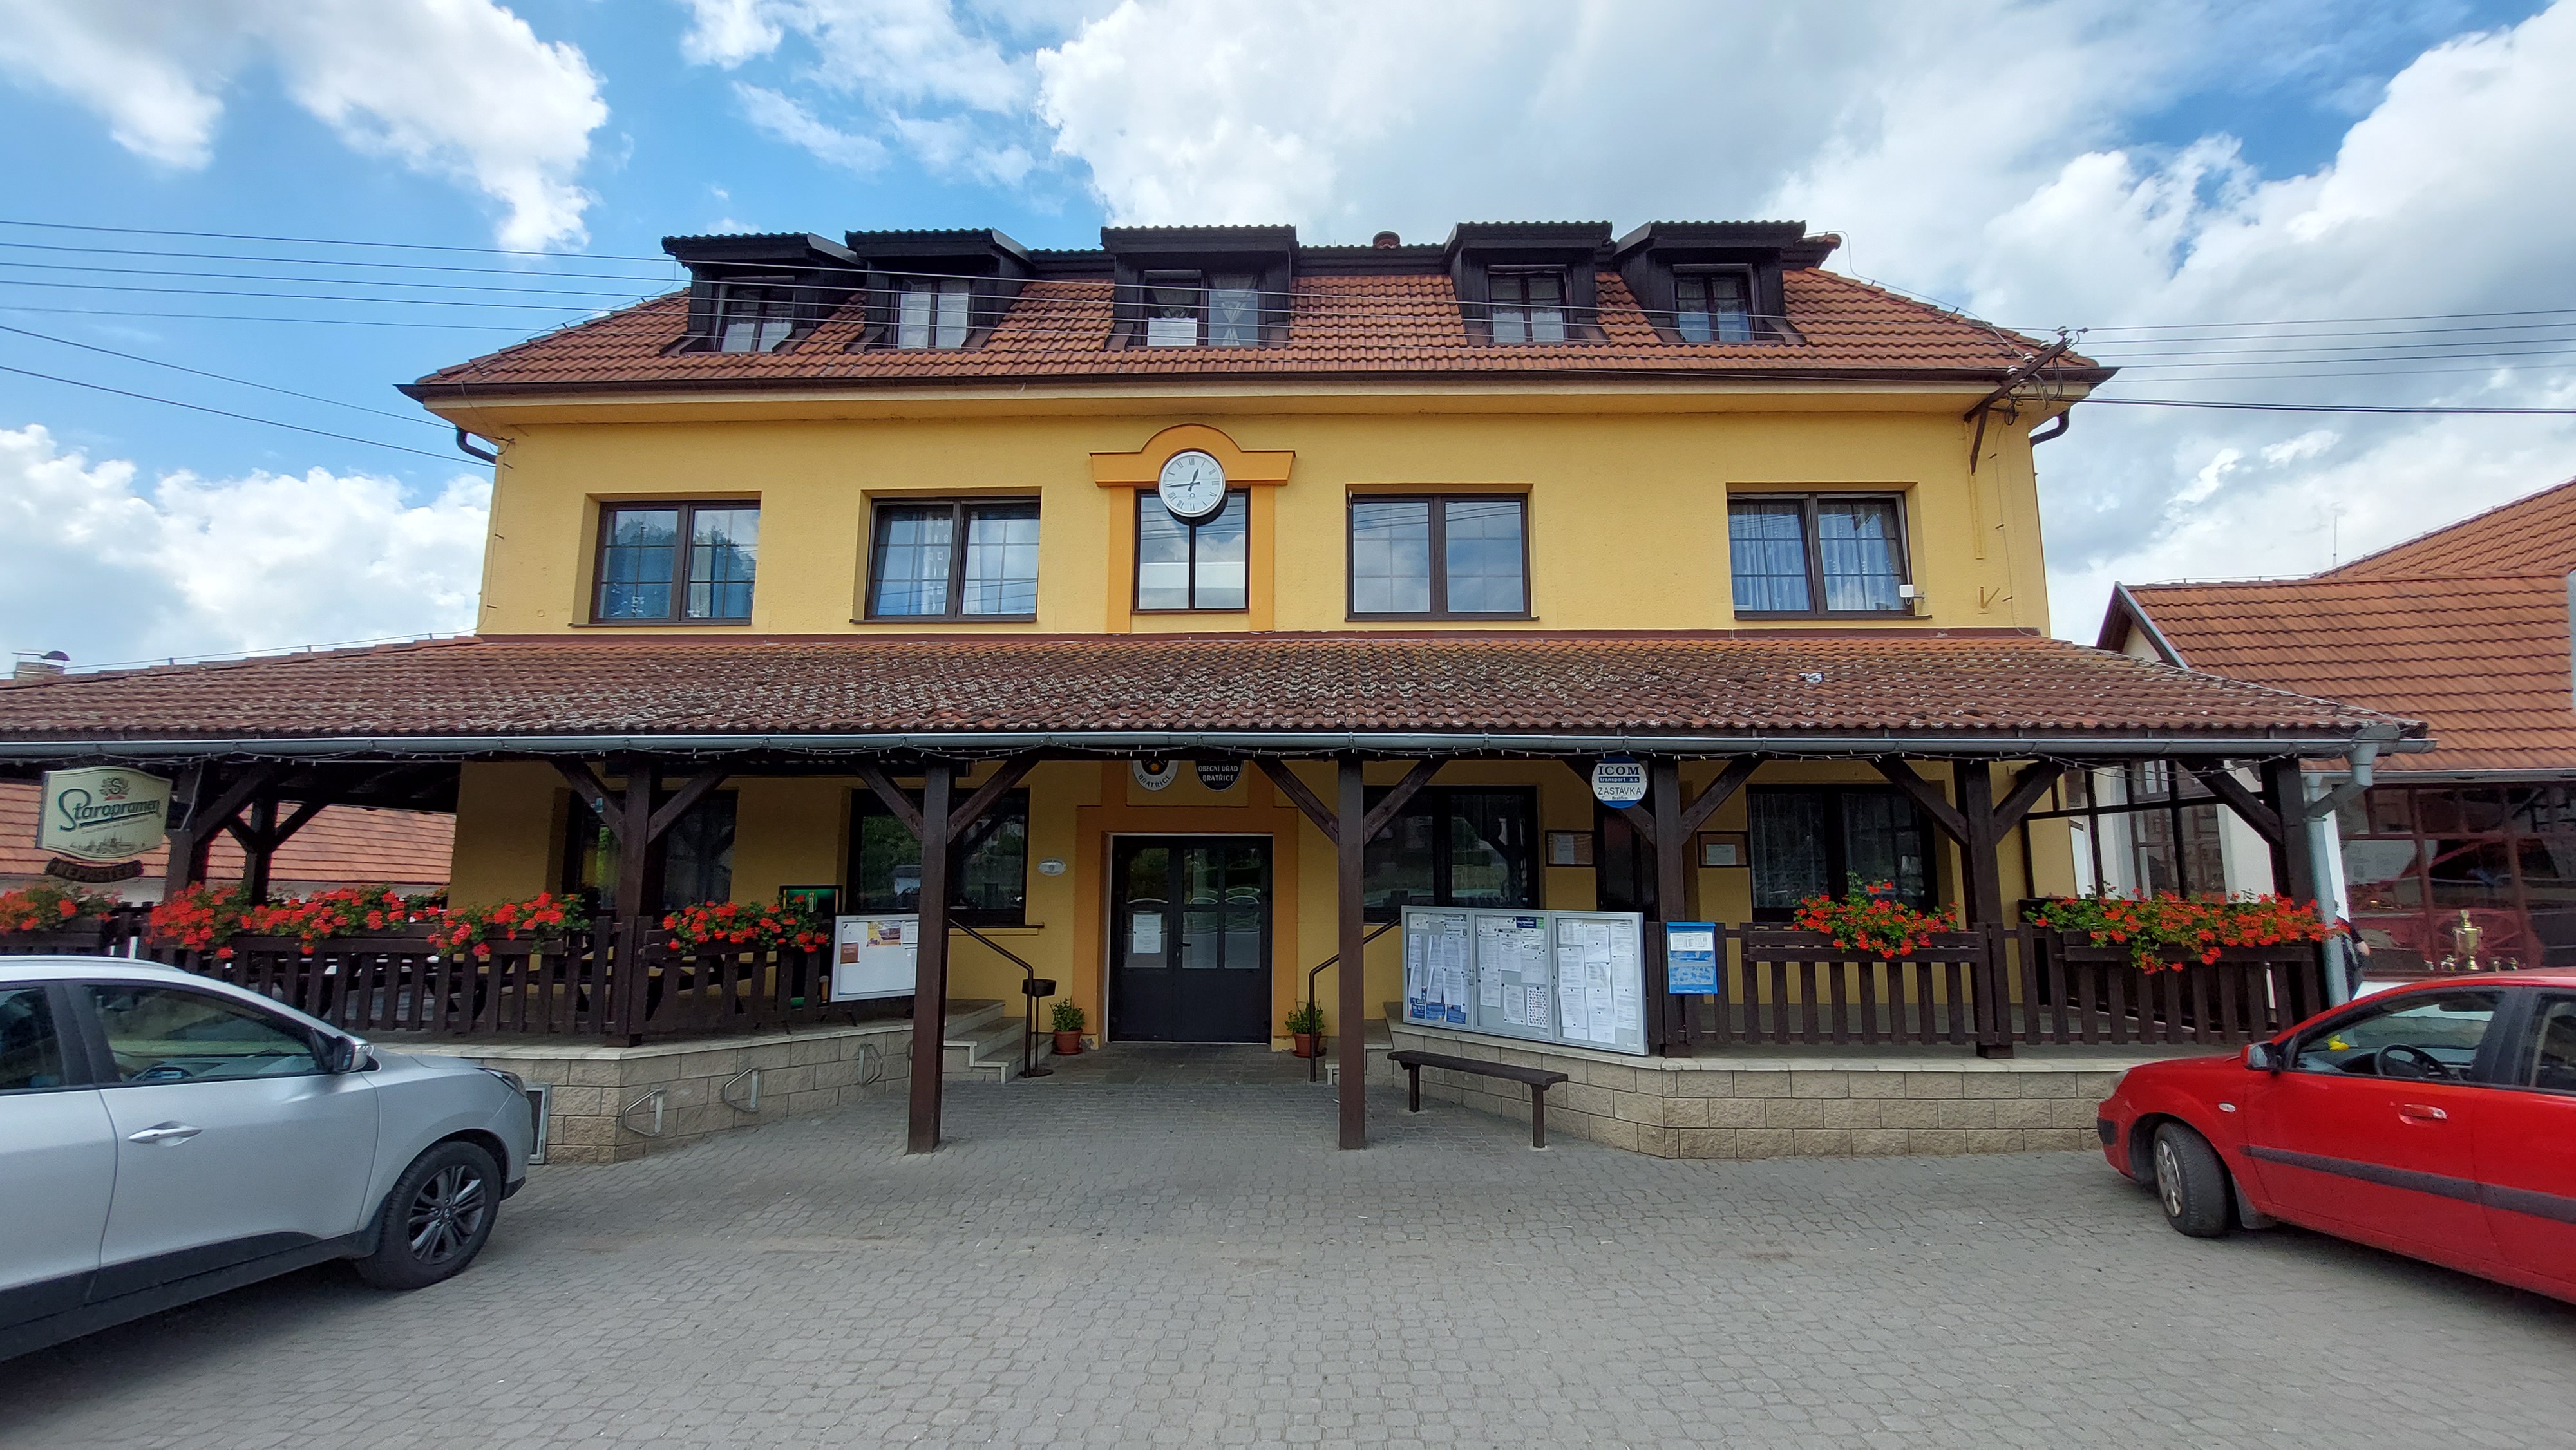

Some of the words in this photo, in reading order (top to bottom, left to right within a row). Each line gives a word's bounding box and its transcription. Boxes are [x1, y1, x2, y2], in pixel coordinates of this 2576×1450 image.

[1598, 766, 1640, 775] ICOM
[1202, 773, 1234, 782] BRATŘICE
[1598, 786, 1642, 795] ZASTÁVKA
[59, 787, 162, 832] Staropramen
